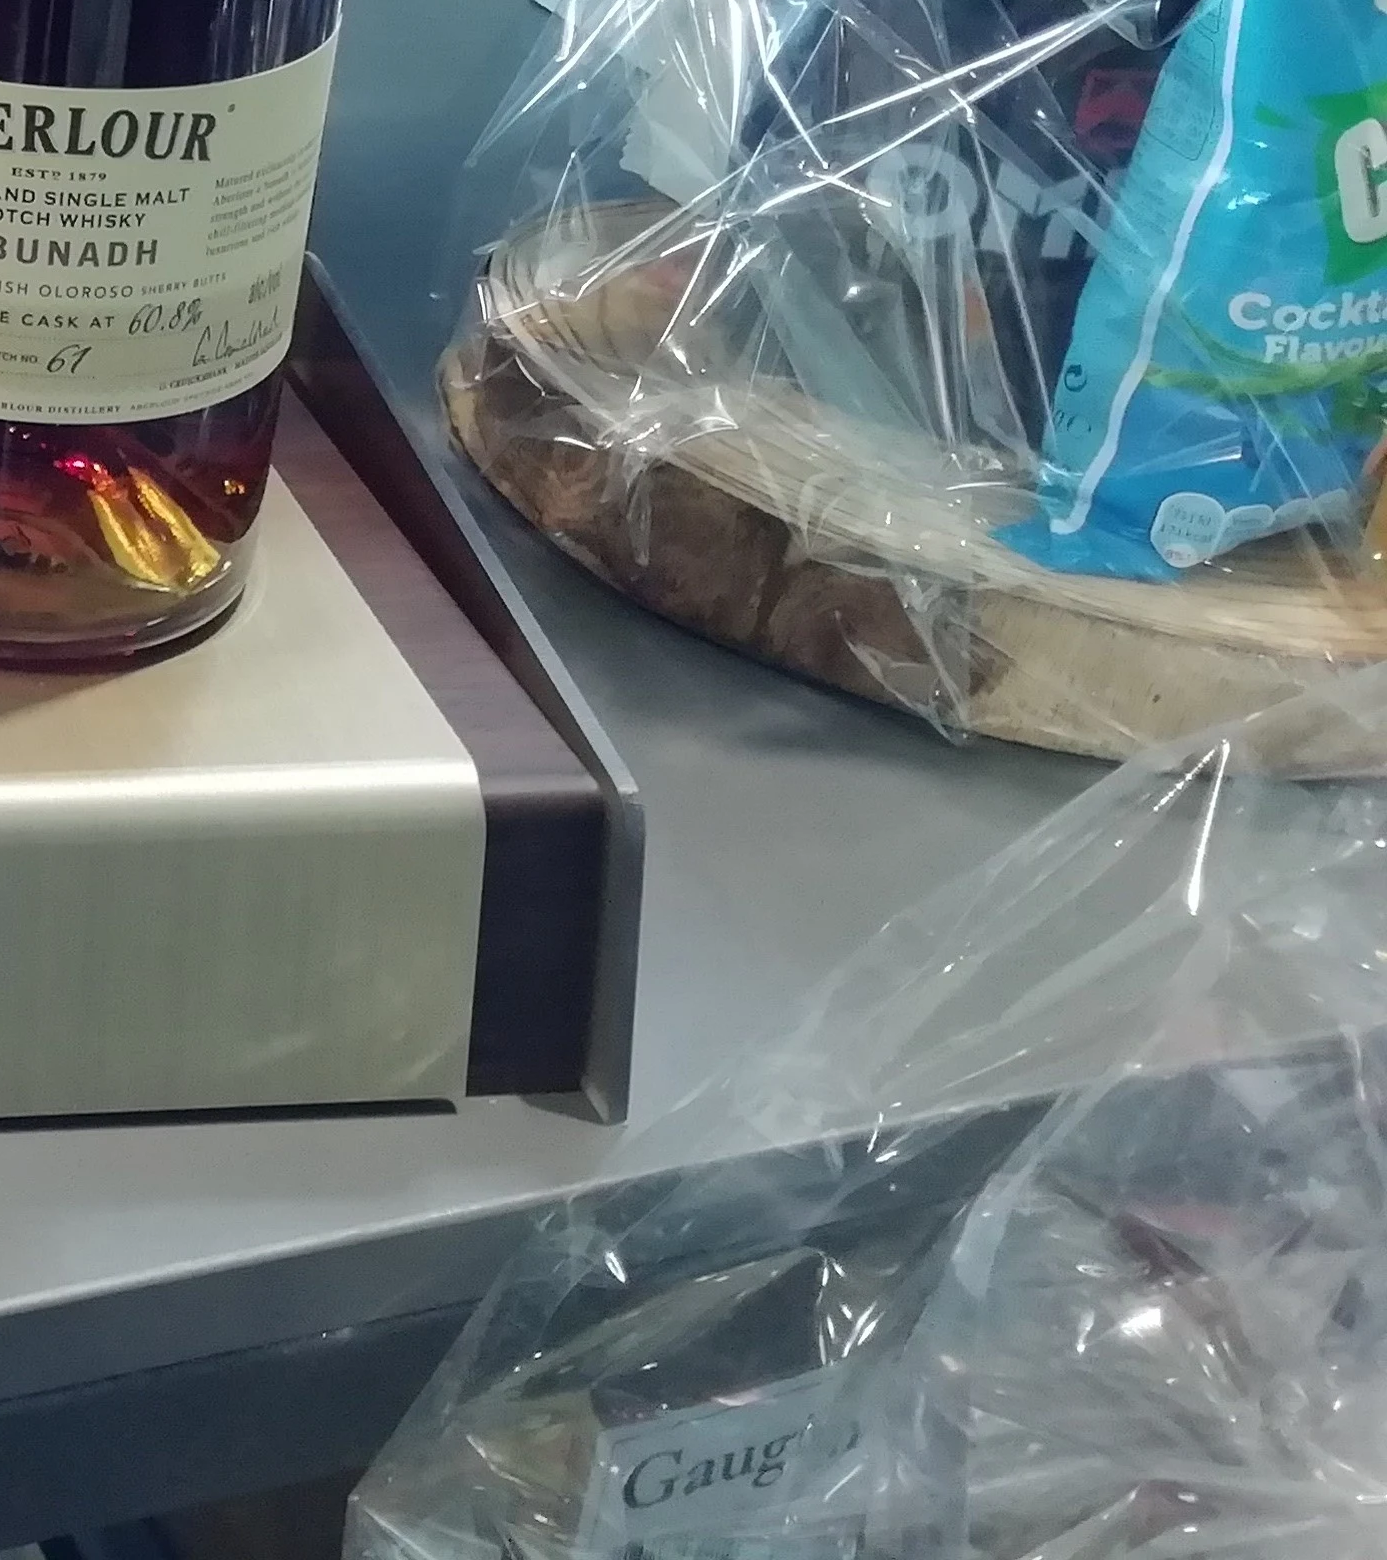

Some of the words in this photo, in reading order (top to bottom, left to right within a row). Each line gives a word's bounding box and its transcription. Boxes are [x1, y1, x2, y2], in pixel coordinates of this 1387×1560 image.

[69, 172, 107, 181] 1879
[44, 191, 127, 207] SINGLE
[135, 188, 190, 206] MALT
[60, 213, 146, 228] WHISKY
[39, 285, 133, 299] OLOROSO
[141, 281, 186, 296] SHERRY
[1229, 290, 1387, 332] Cockt
[21, 314, 78, 328] CASK
[90, 316, 115, 328] AT
[48, 404, 121, 415] DISTILLERY
